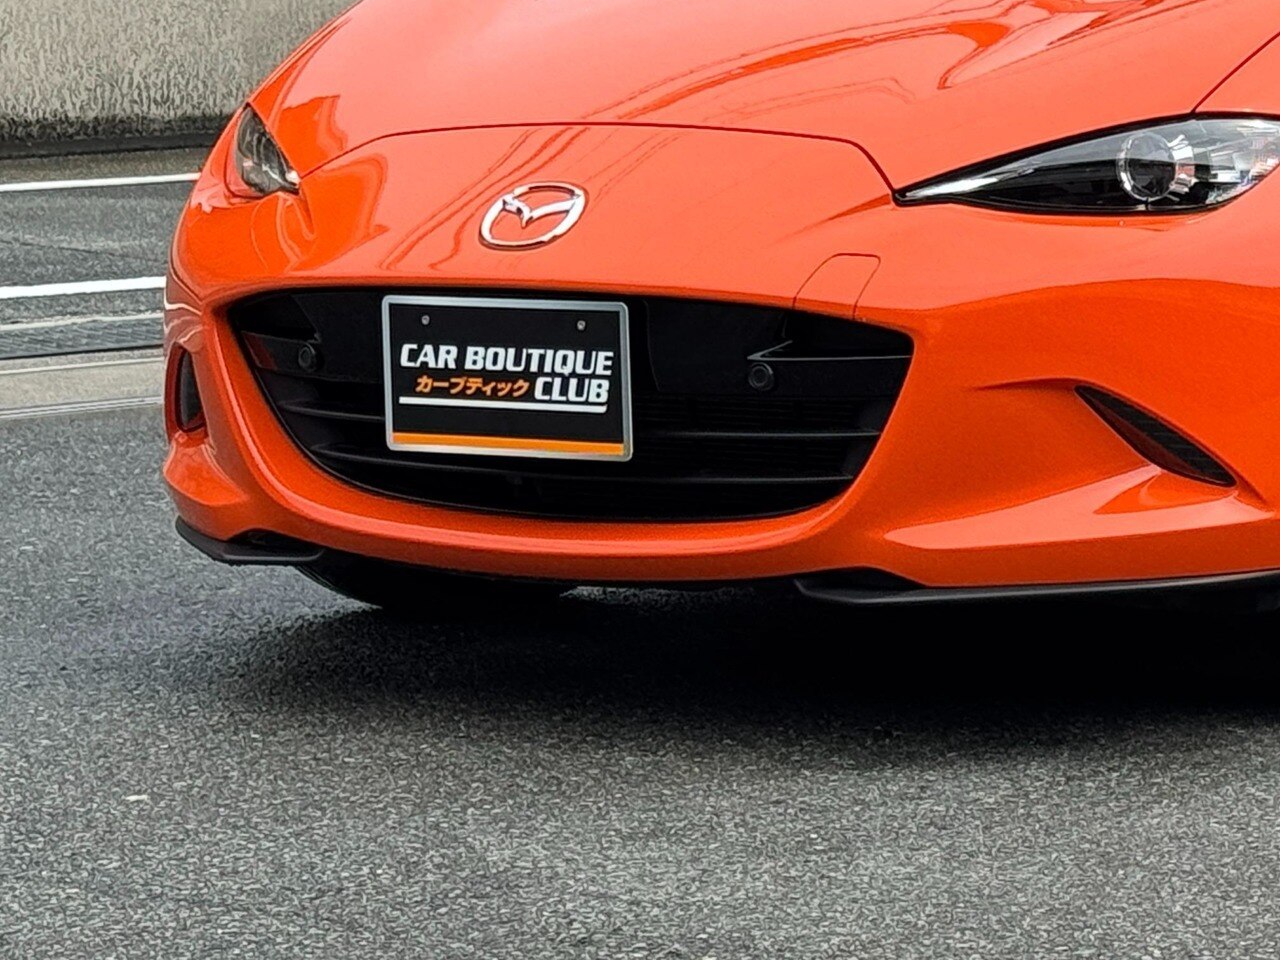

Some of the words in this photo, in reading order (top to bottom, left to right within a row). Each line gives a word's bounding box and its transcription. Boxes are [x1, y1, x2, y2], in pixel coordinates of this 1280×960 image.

[401, 344, 458, 369] CAR
[464, 346, 614, 376] BOUTIQUE
[415, 375, 530, 397] カーブティック
[534, 377, 610, 403] CLUB
